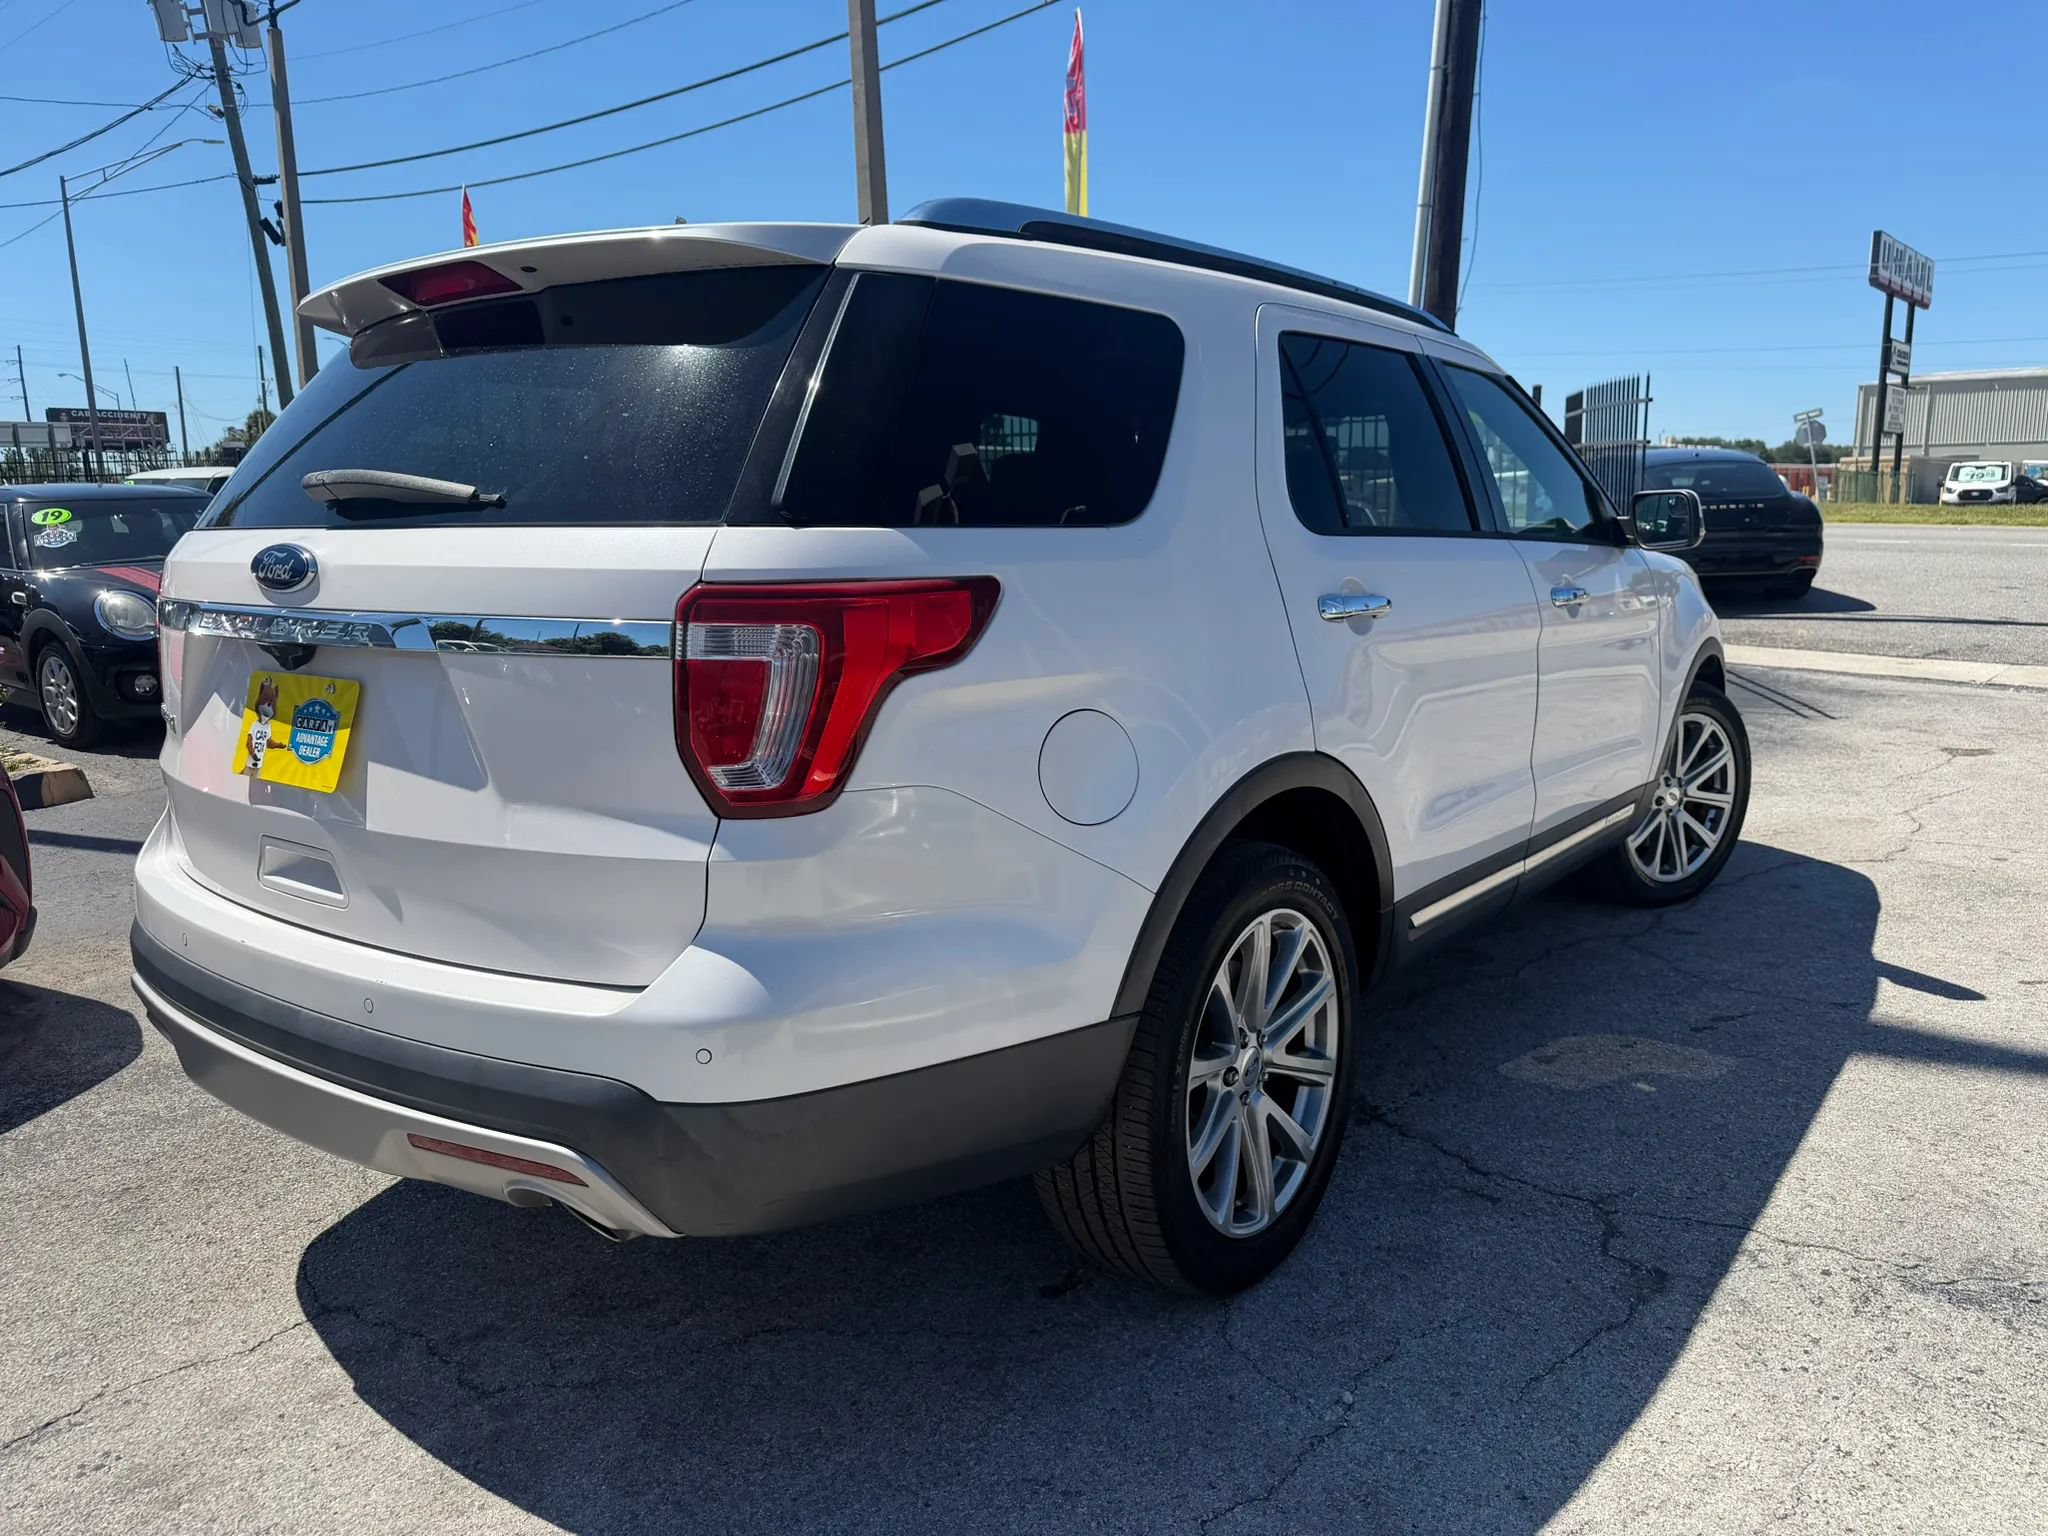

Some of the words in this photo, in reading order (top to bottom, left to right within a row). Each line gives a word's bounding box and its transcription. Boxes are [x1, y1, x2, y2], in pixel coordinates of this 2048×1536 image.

[41, 511, 62, 522] 19
[258, 550, 294, 580] Ford
[199, 613, 373, 645] EXPLORER
[296, 718, 334, 734] CARFAX
[255, 730, 267, 740] CAR
[296, 732, 329, 747] ADVANTAGE
[299, 745, 320, 758] DEALER
